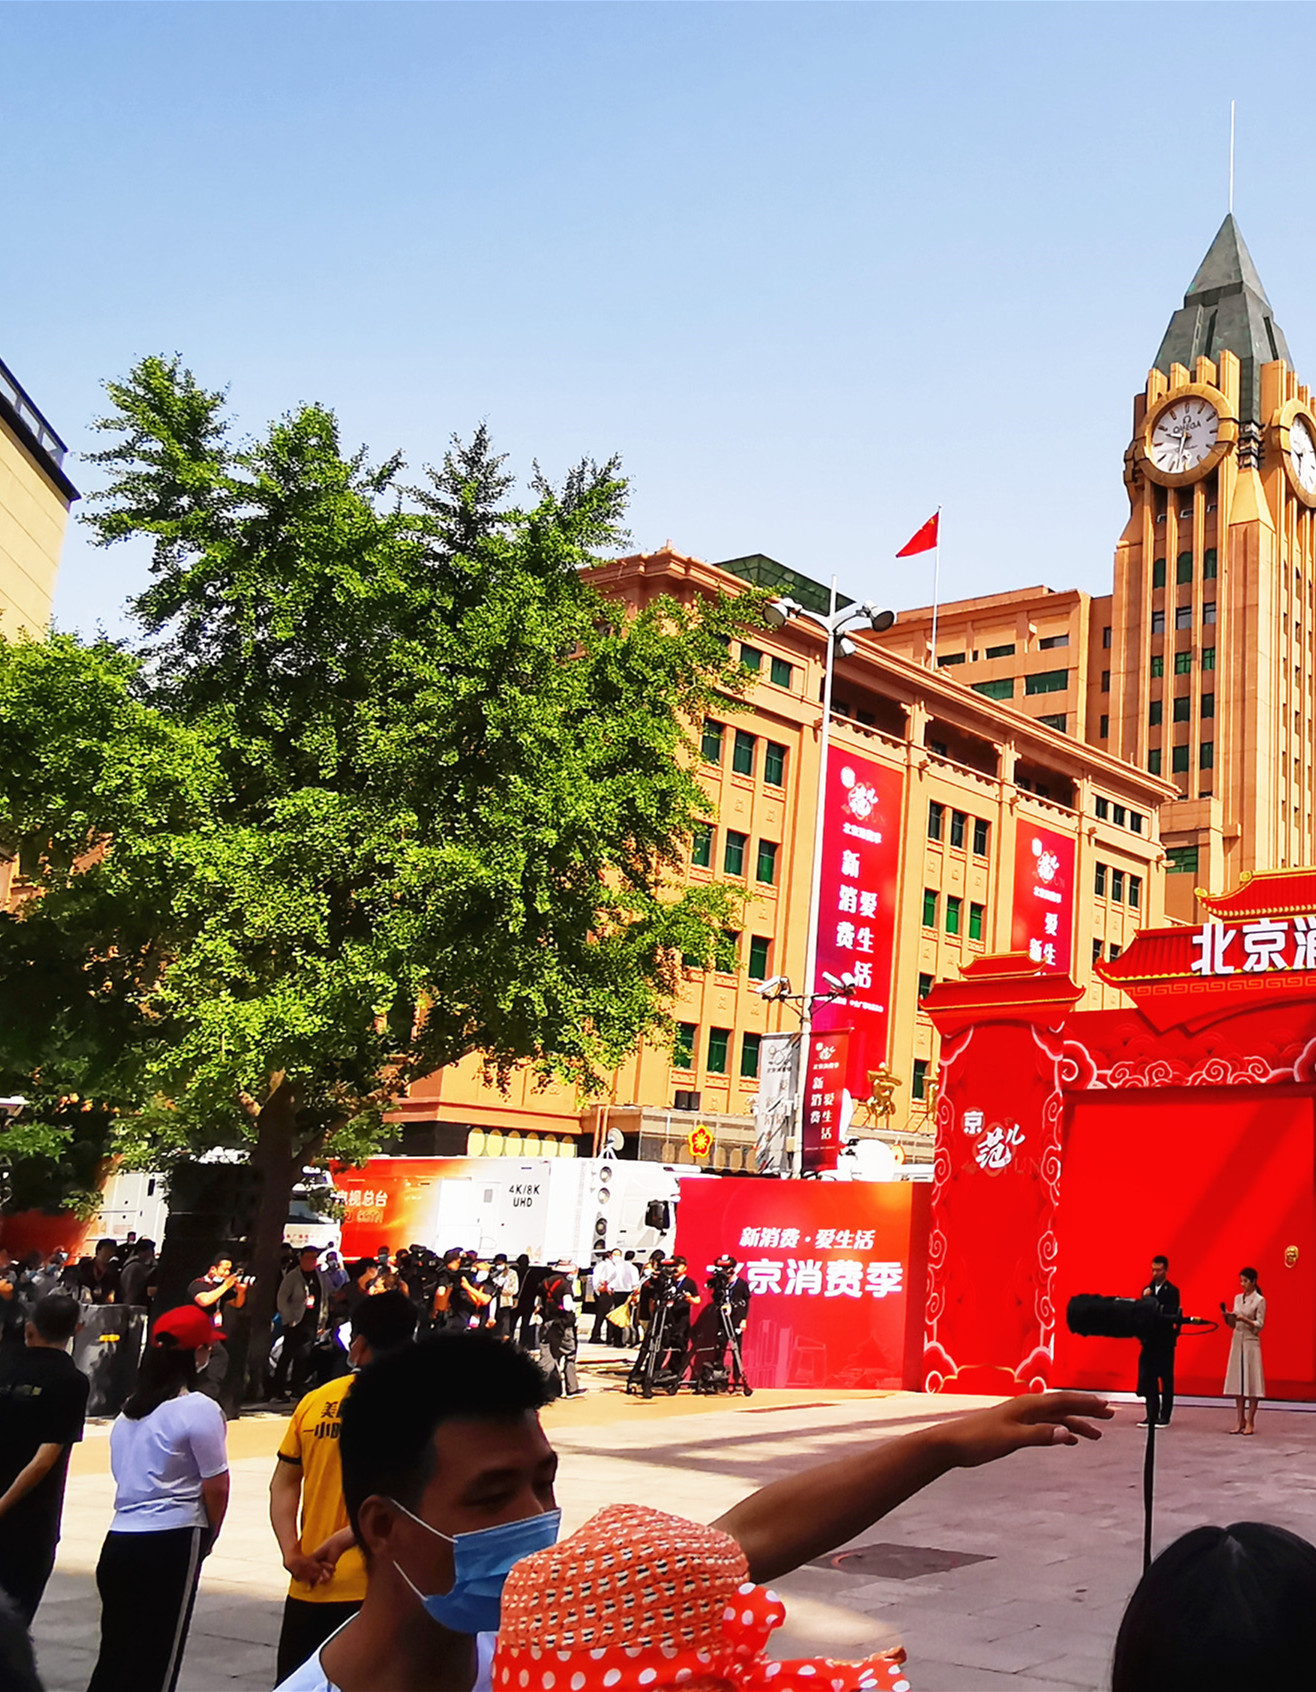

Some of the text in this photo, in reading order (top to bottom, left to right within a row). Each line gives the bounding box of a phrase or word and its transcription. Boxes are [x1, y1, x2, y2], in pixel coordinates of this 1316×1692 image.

[509, 1184, 540, 1195] 4K/8K
[513, 1197, 533, 1207] UHD
[705, 1258, 903, 1298] 京消费季
